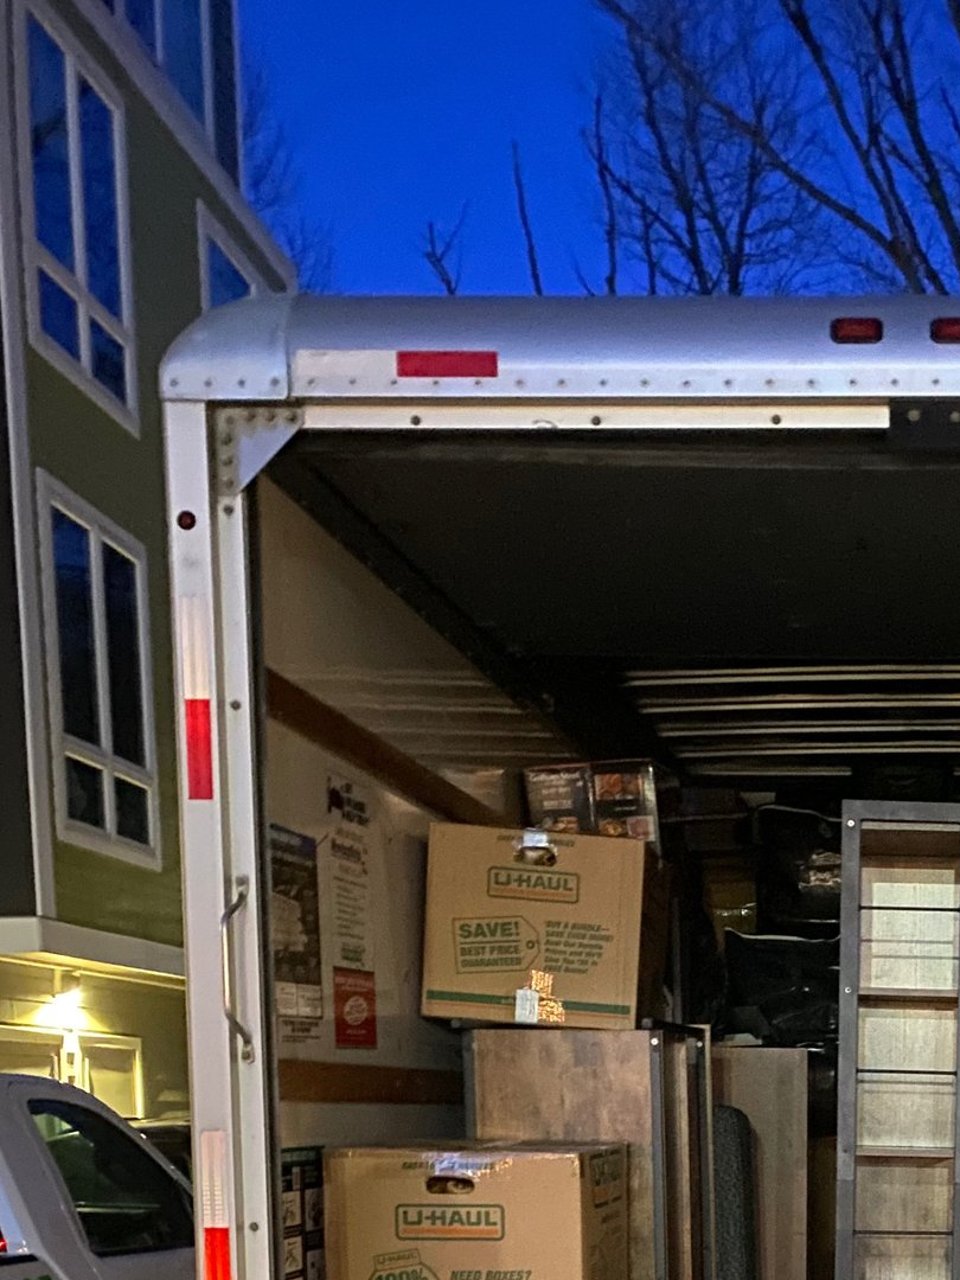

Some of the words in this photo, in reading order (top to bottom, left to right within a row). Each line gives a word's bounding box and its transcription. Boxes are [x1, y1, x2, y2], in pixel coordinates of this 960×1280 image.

[493, 872, 574, 891] U-HAUL
[459, 921, 520, 939] SAVE!
[459, 945, 486, 957] BEST
[489, 945, 519, 956] PRICE
[460, 957, 523, 968] GUARANTEED
[402, 1210, 498, 1226] U-HAUL
